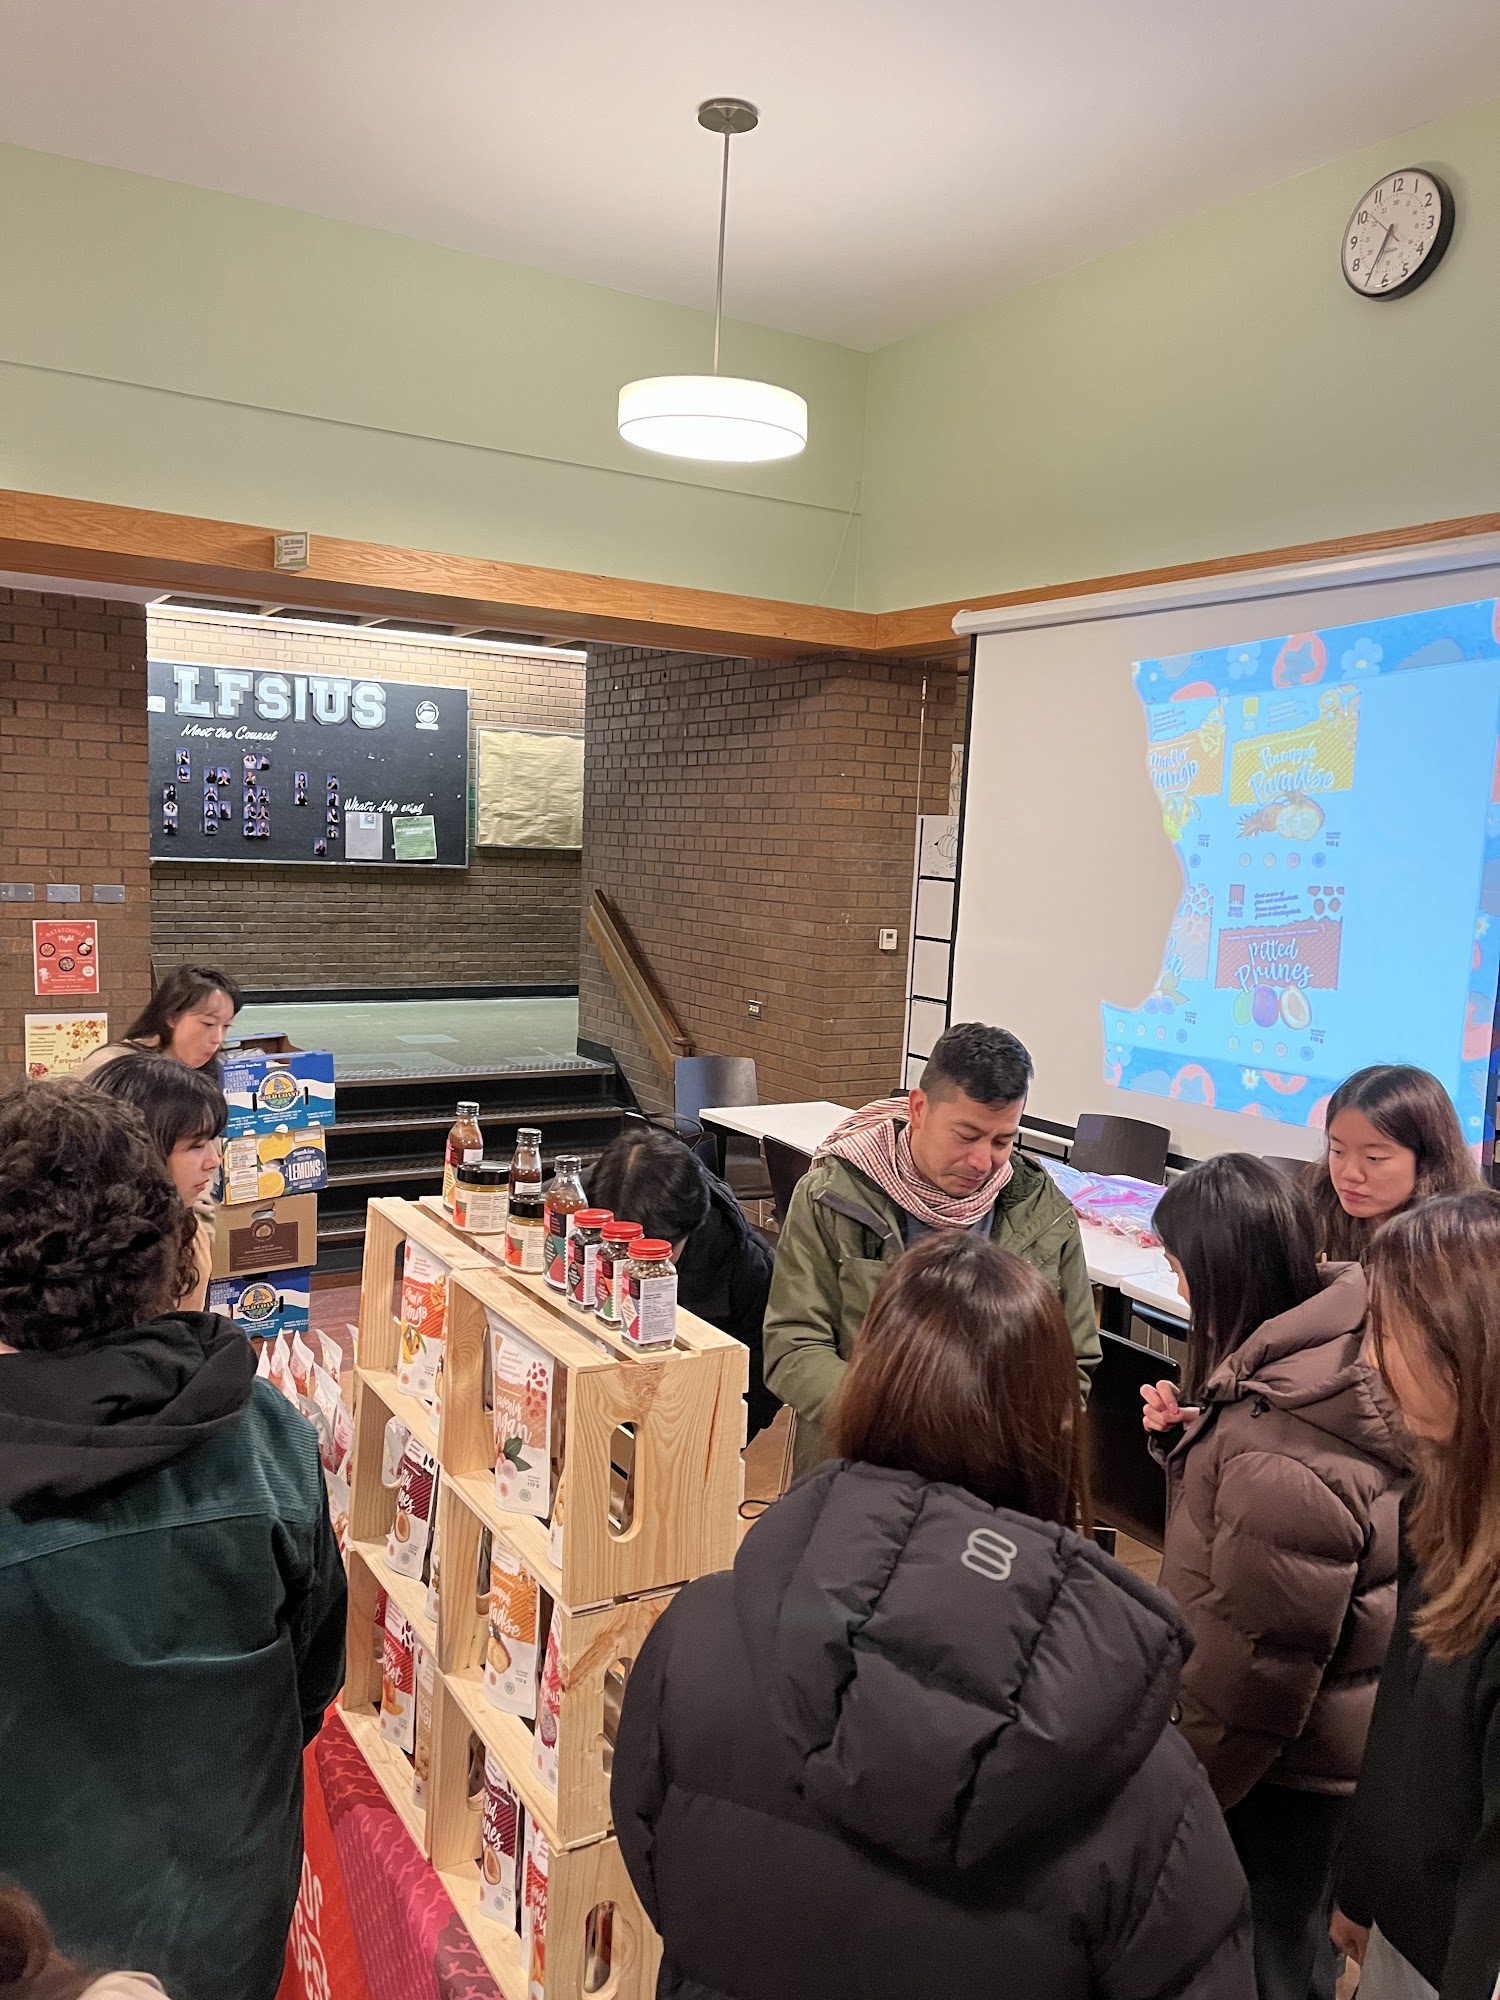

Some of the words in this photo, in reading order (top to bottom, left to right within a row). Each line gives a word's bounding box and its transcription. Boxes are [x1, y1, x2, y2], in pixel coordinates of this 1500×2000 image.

[1393, 178, 1404, 193] 12
[1414, 179, 1419, 193] 1
[1374, 189, 1383, 204] 11
[1424, 192, 1433, 207] 2
[1357, 210, 1368, 225] 10
[1426, 215, 1435, 229] 3
[1350, 236, 1358, 250] 9
[1416, 241, 1424, 255] 4
[1352, 258, 1360, 272] 8
[1401, 263, 1409, 277] 5
[1381, 274, 1389, 288] 6
[180, 723, 215, 738] Meet
[214, 727, 233, 739] the
[234, 725, 279, 741] Council
[1258, 740, 1317, 770] Pineapple
[1248, 762, 1336, 806] Paradise
[1234, 962, 1314, 994] Prunes
[288, 1159, 321, 1181] LEMONS
